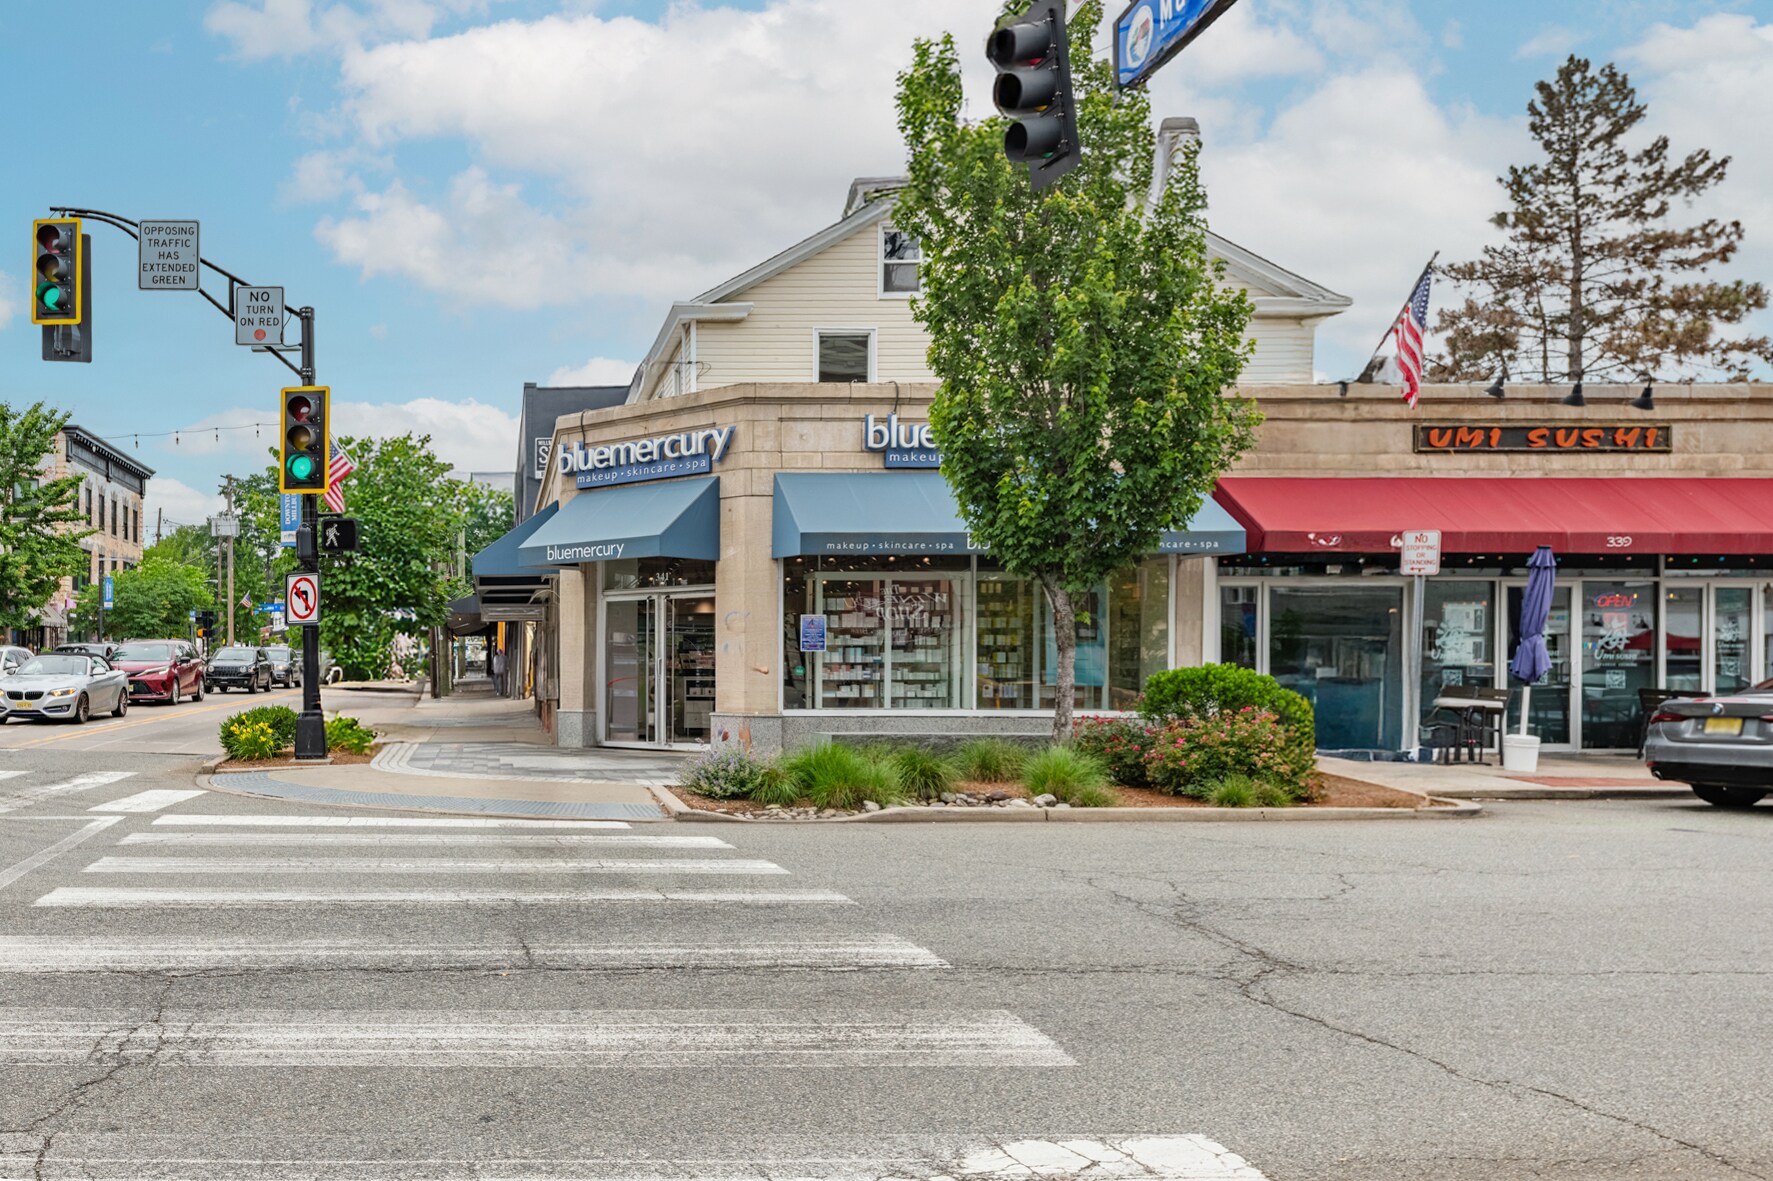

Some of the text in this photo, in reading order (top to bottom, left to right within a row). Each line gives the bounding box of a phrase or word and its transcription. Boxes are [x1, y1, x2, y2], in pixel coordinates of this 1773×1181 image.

[144, 226, 195, 236] OPPOSING
[148, 239, 191, 248] TRAFFIC
[158, 251, 180, 260] HAS
[142, 263, 195, 272] EXTENDED
[152, 276, 186, 284] GREEN
[249, 291, 270, 302] NO
[246, 305, 274, 314] TURN
[240, 317, 280, 326] ON RED
[1428, 426, 1659, 448] UMI SUSHI
[557, 426, 735, 475] bluemercury
[889, 451, 945, 465] makeup
[577, 459, 707, 484] makeup skincare spa
[1415, 535, 1428, 543] NO
[1606, 536, 1633, 548] 339
[826, 541, 869, 551] makeup
[878, 540, 926, 550] skincare
[936, 542, 954, 551] spa
[1200, 541, 1219, 549] spa
[547, 543, 625, 561] bluemercury
[1597, 594, 1634, 608] OPEN
